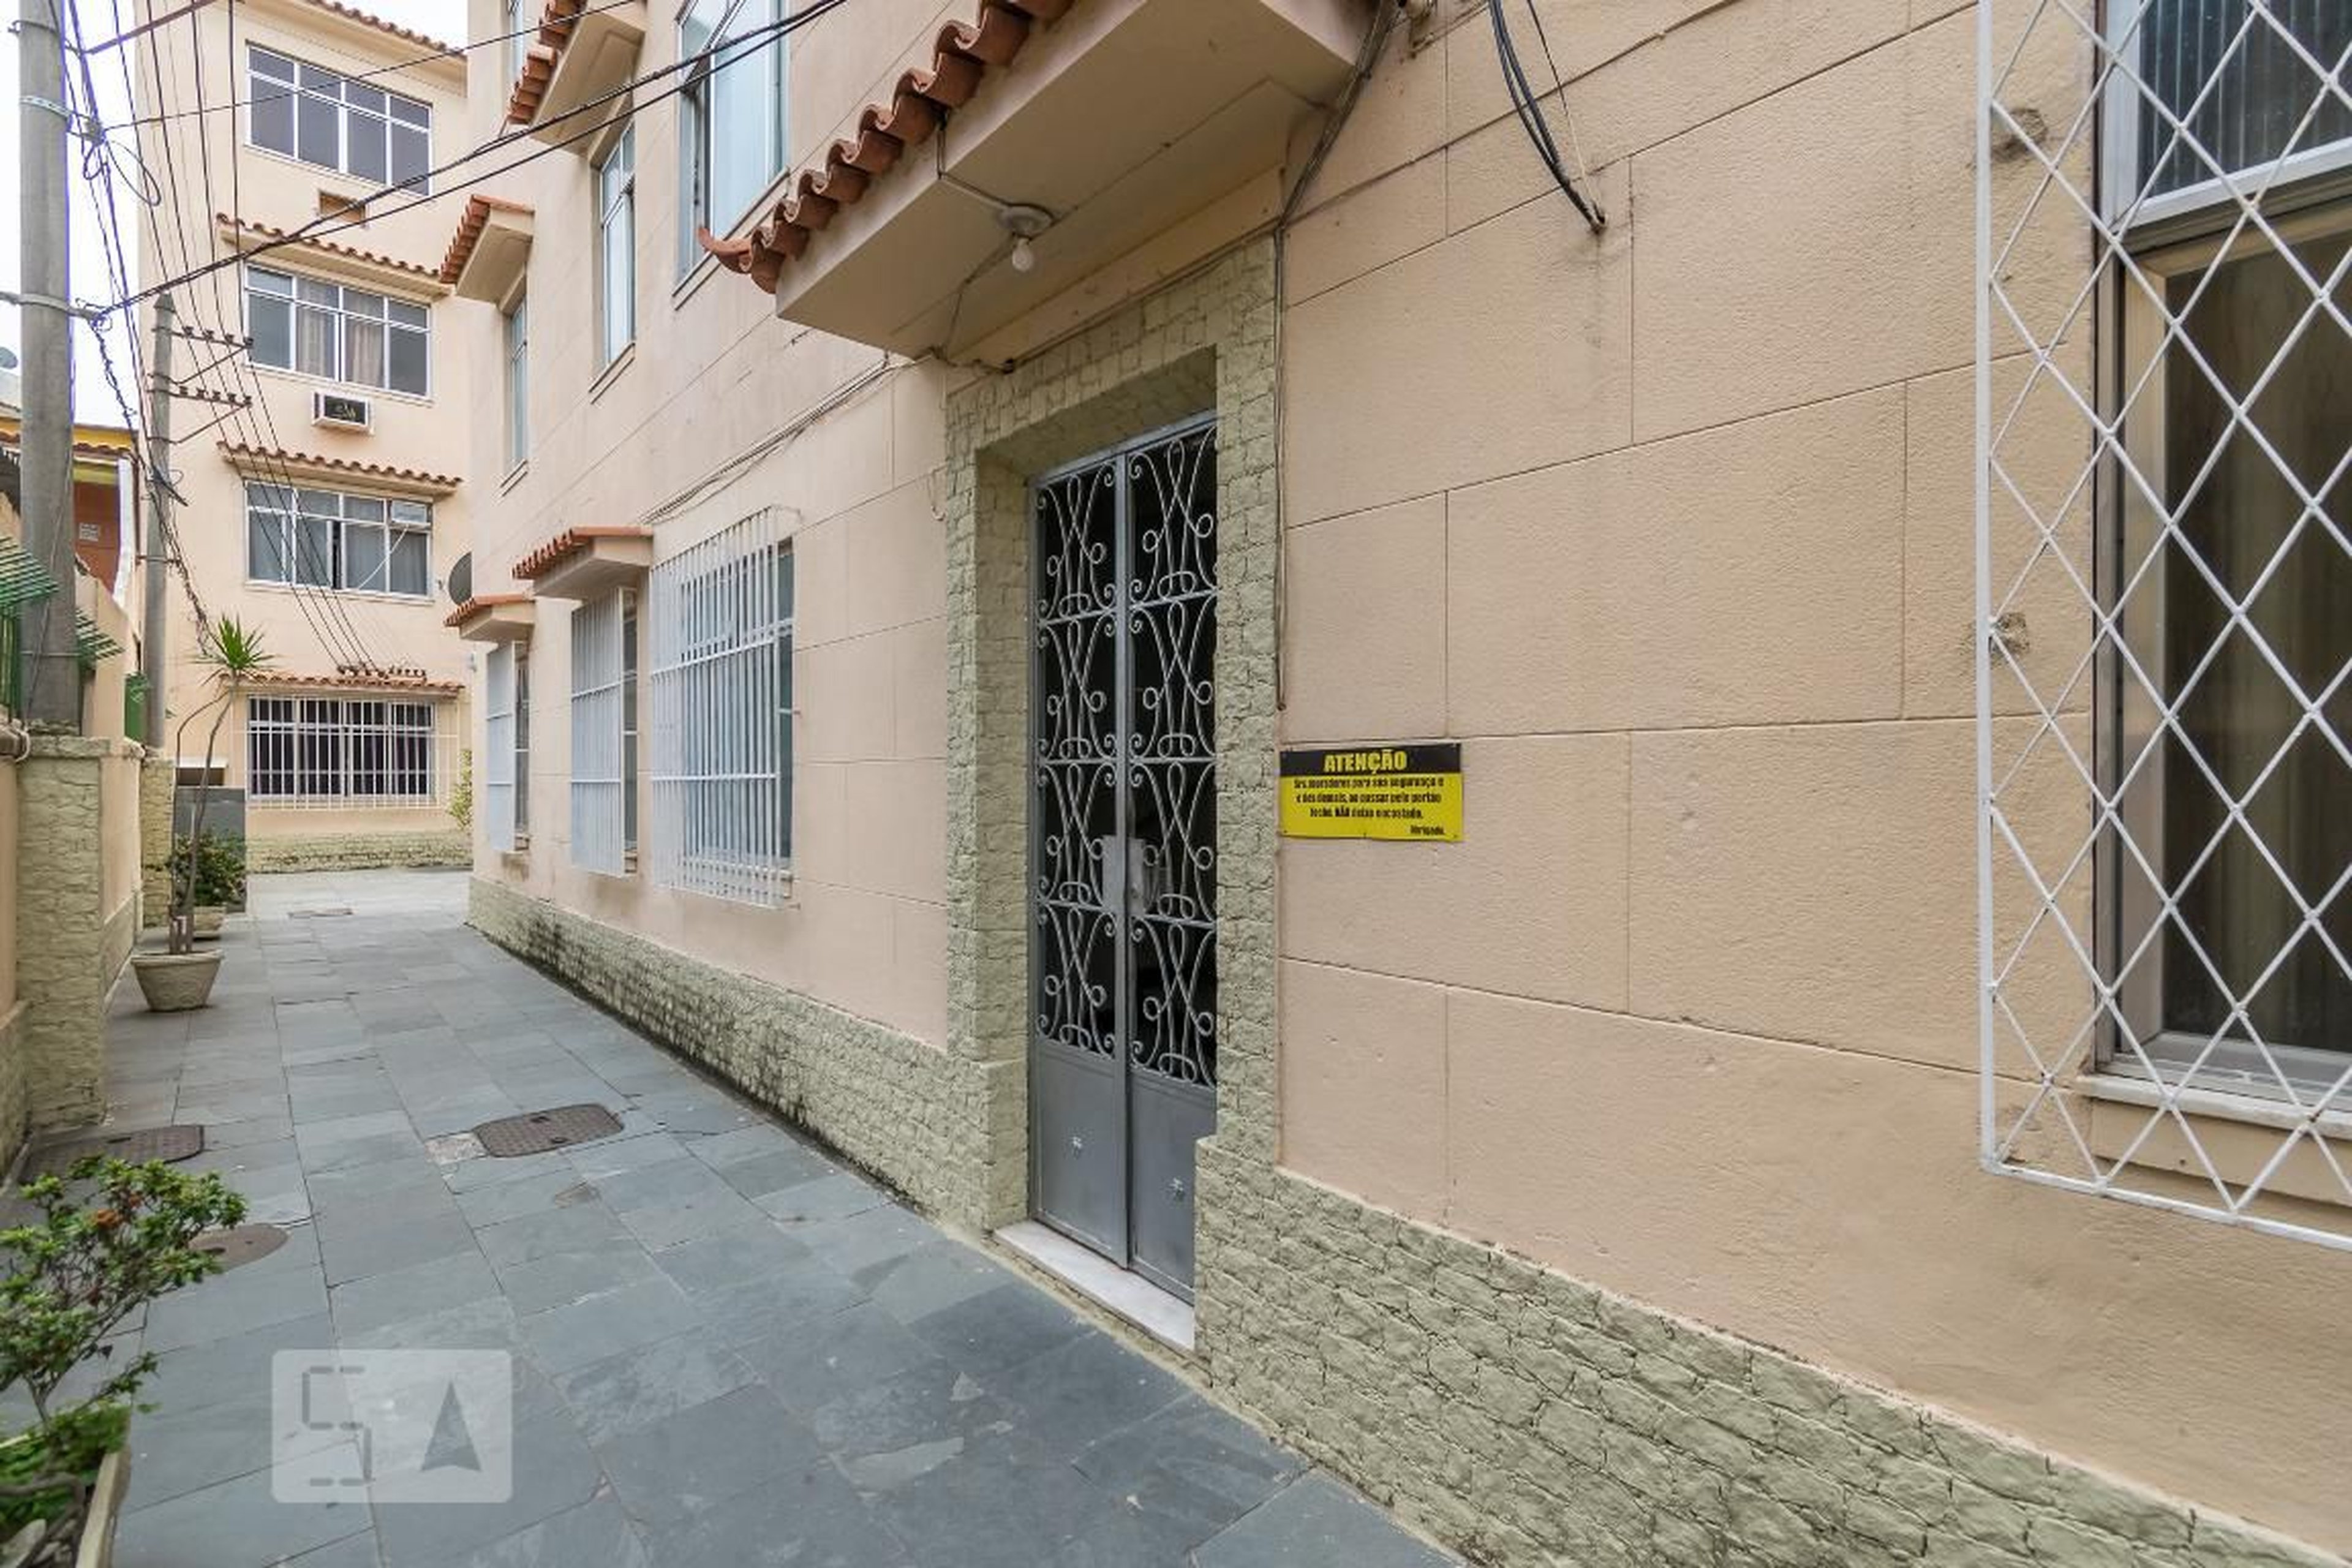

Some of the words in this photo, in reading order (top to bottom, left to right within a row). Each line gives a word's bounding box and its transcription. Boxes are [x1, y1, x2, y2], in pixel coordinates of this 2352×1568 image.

[1324, 749, 1408, 774] ATENÇÃO
[1390, 777, 1436, 789] segurança
[1411, 791, 1442, 804] portão
